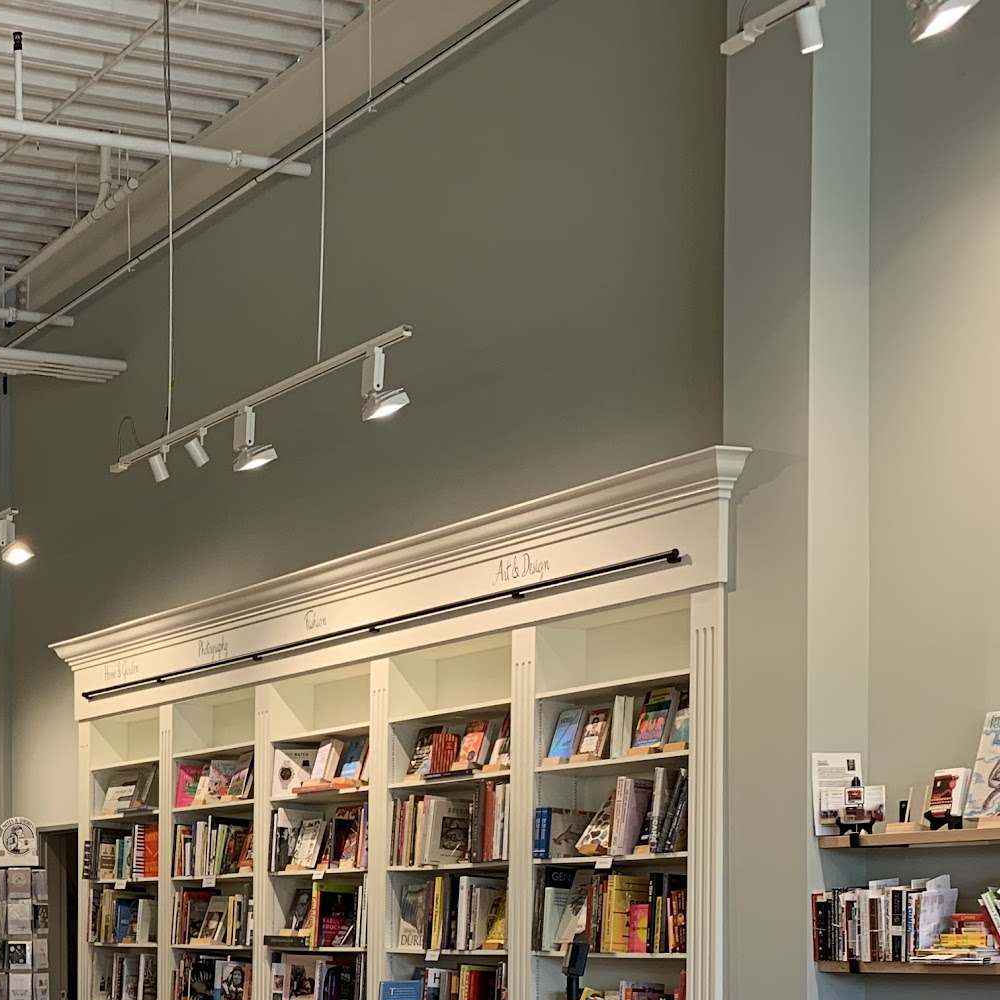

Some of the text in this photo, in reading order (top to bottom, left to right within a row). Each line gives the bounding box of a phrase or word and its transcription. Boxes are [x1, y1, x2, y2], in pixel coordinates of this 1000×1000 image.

[492, 553, 550, 586] Art & Design
